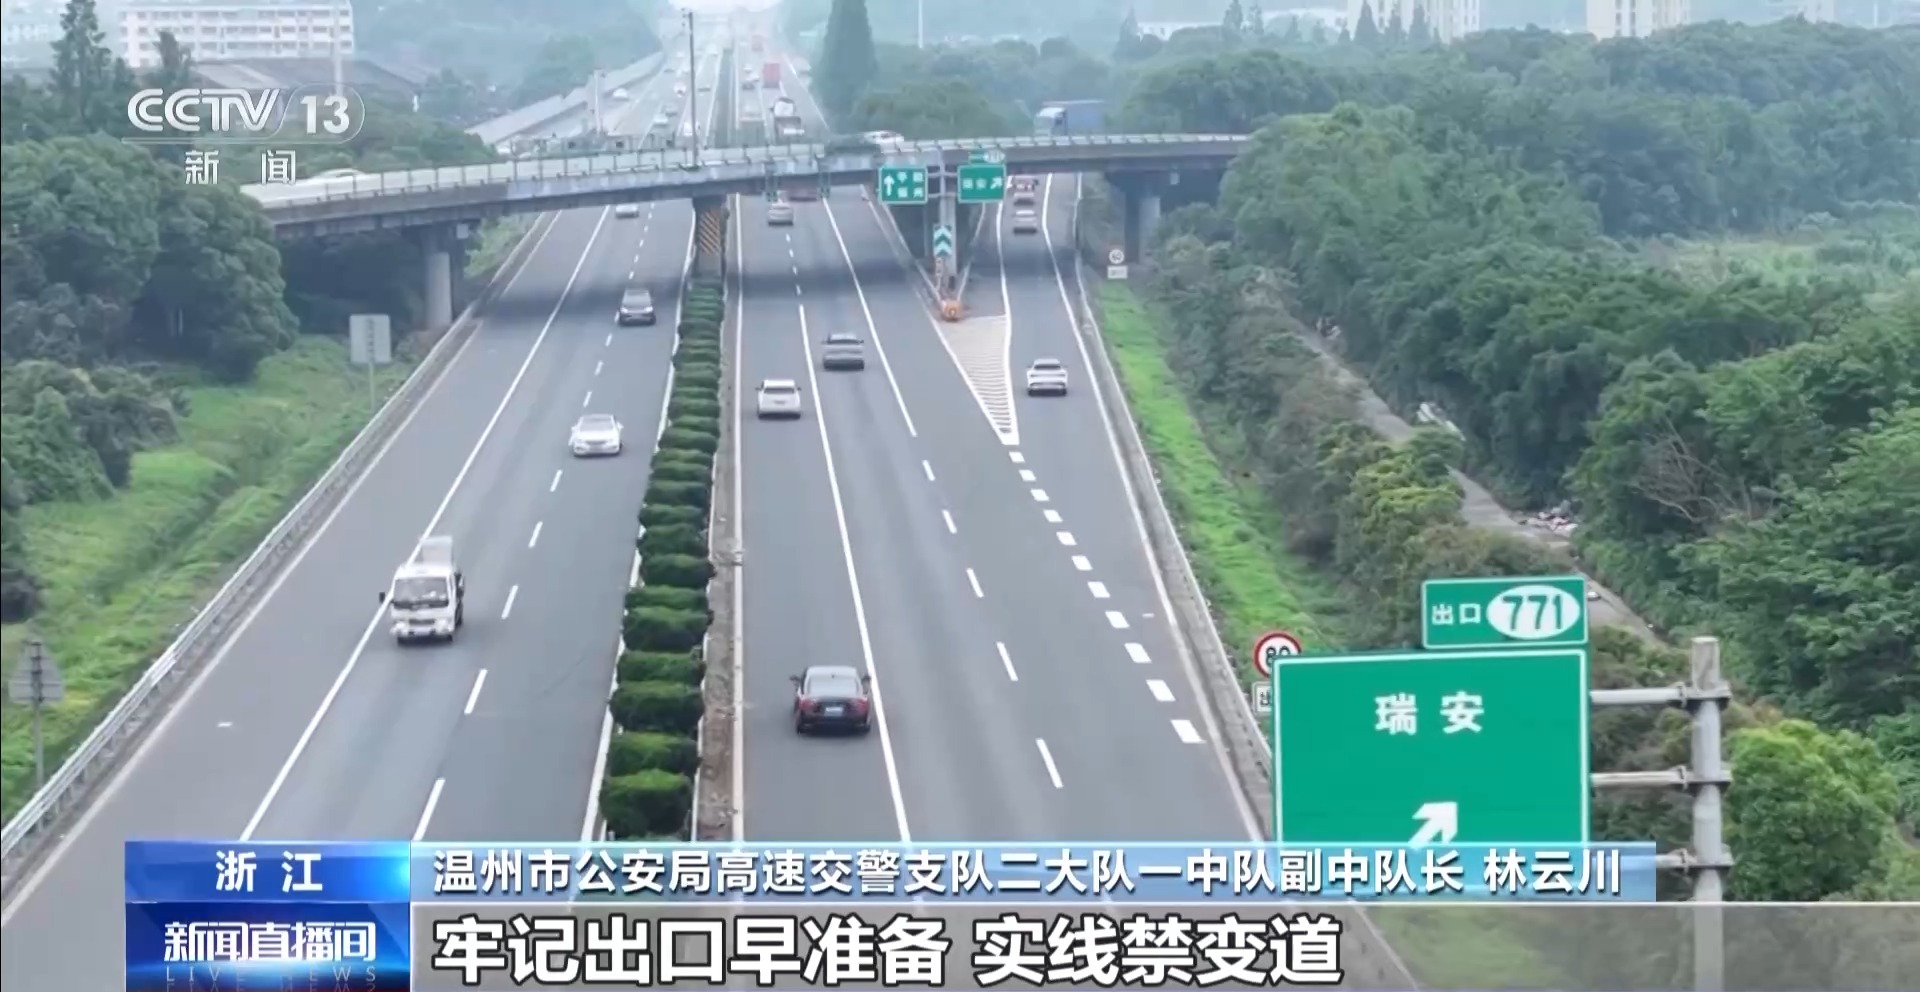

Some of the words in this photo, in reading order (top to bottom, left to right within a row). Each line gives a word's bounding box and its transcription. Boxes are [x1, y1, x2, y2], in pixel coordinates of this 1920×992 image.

[1432, 603, 1481, 625] 出口
[1502, 595, 1562, 631] 771
[1374, 691, 1485, 735] 瑞安
